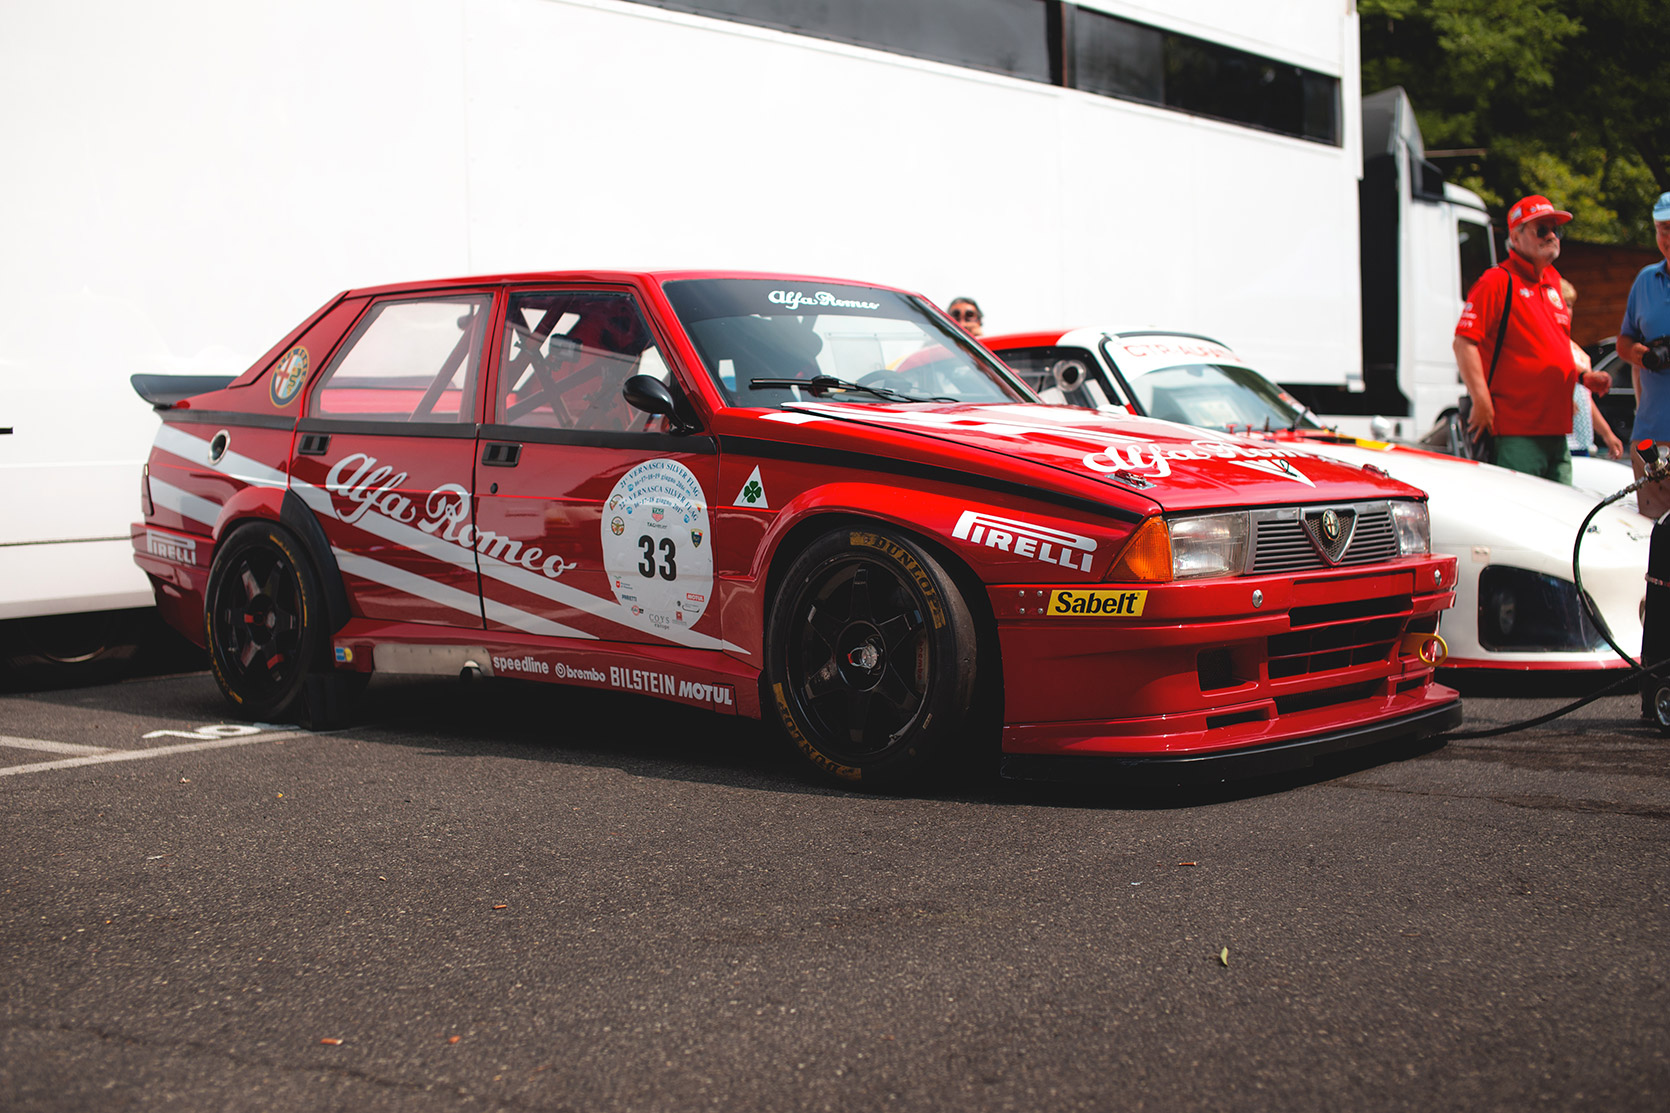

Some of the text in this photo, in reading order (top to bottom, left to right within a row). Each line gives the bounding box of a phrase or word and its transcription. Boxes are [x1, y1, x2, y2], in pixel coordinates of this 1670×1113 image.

[768, 289, 881, 311] Alfa Romeo
[1082, 443, 1205, 478] Alfa
[628, 462, 665, 480] VERNASCA
[666, 463, 689, 480] SILVER
[686, 477, 701, 497] FLAG
[325, 452, 578, 579] Alfa Romeo
[627, 485, 663, 501] VERNASCA
[664, 486, 686, 503] SILVER
[684, 501, 700, 521] FLAG
[146, 528, 198, 566] PIRELLI
[638, 534, 677, 582] 33
[951, 510, 1098, 573] PIRELLI
[871, 533, 942, 609] DUNLOP
[648, 613, 670, 624] COYS
[1054, 591, 1139, 615] Sabelt
[493, 655, 549, 675] speedline
[566, 667, 606, 683] brembo
[610, 666, 676, 697] BILSTEIN
[678, 679, 733, 706] MOTUL
